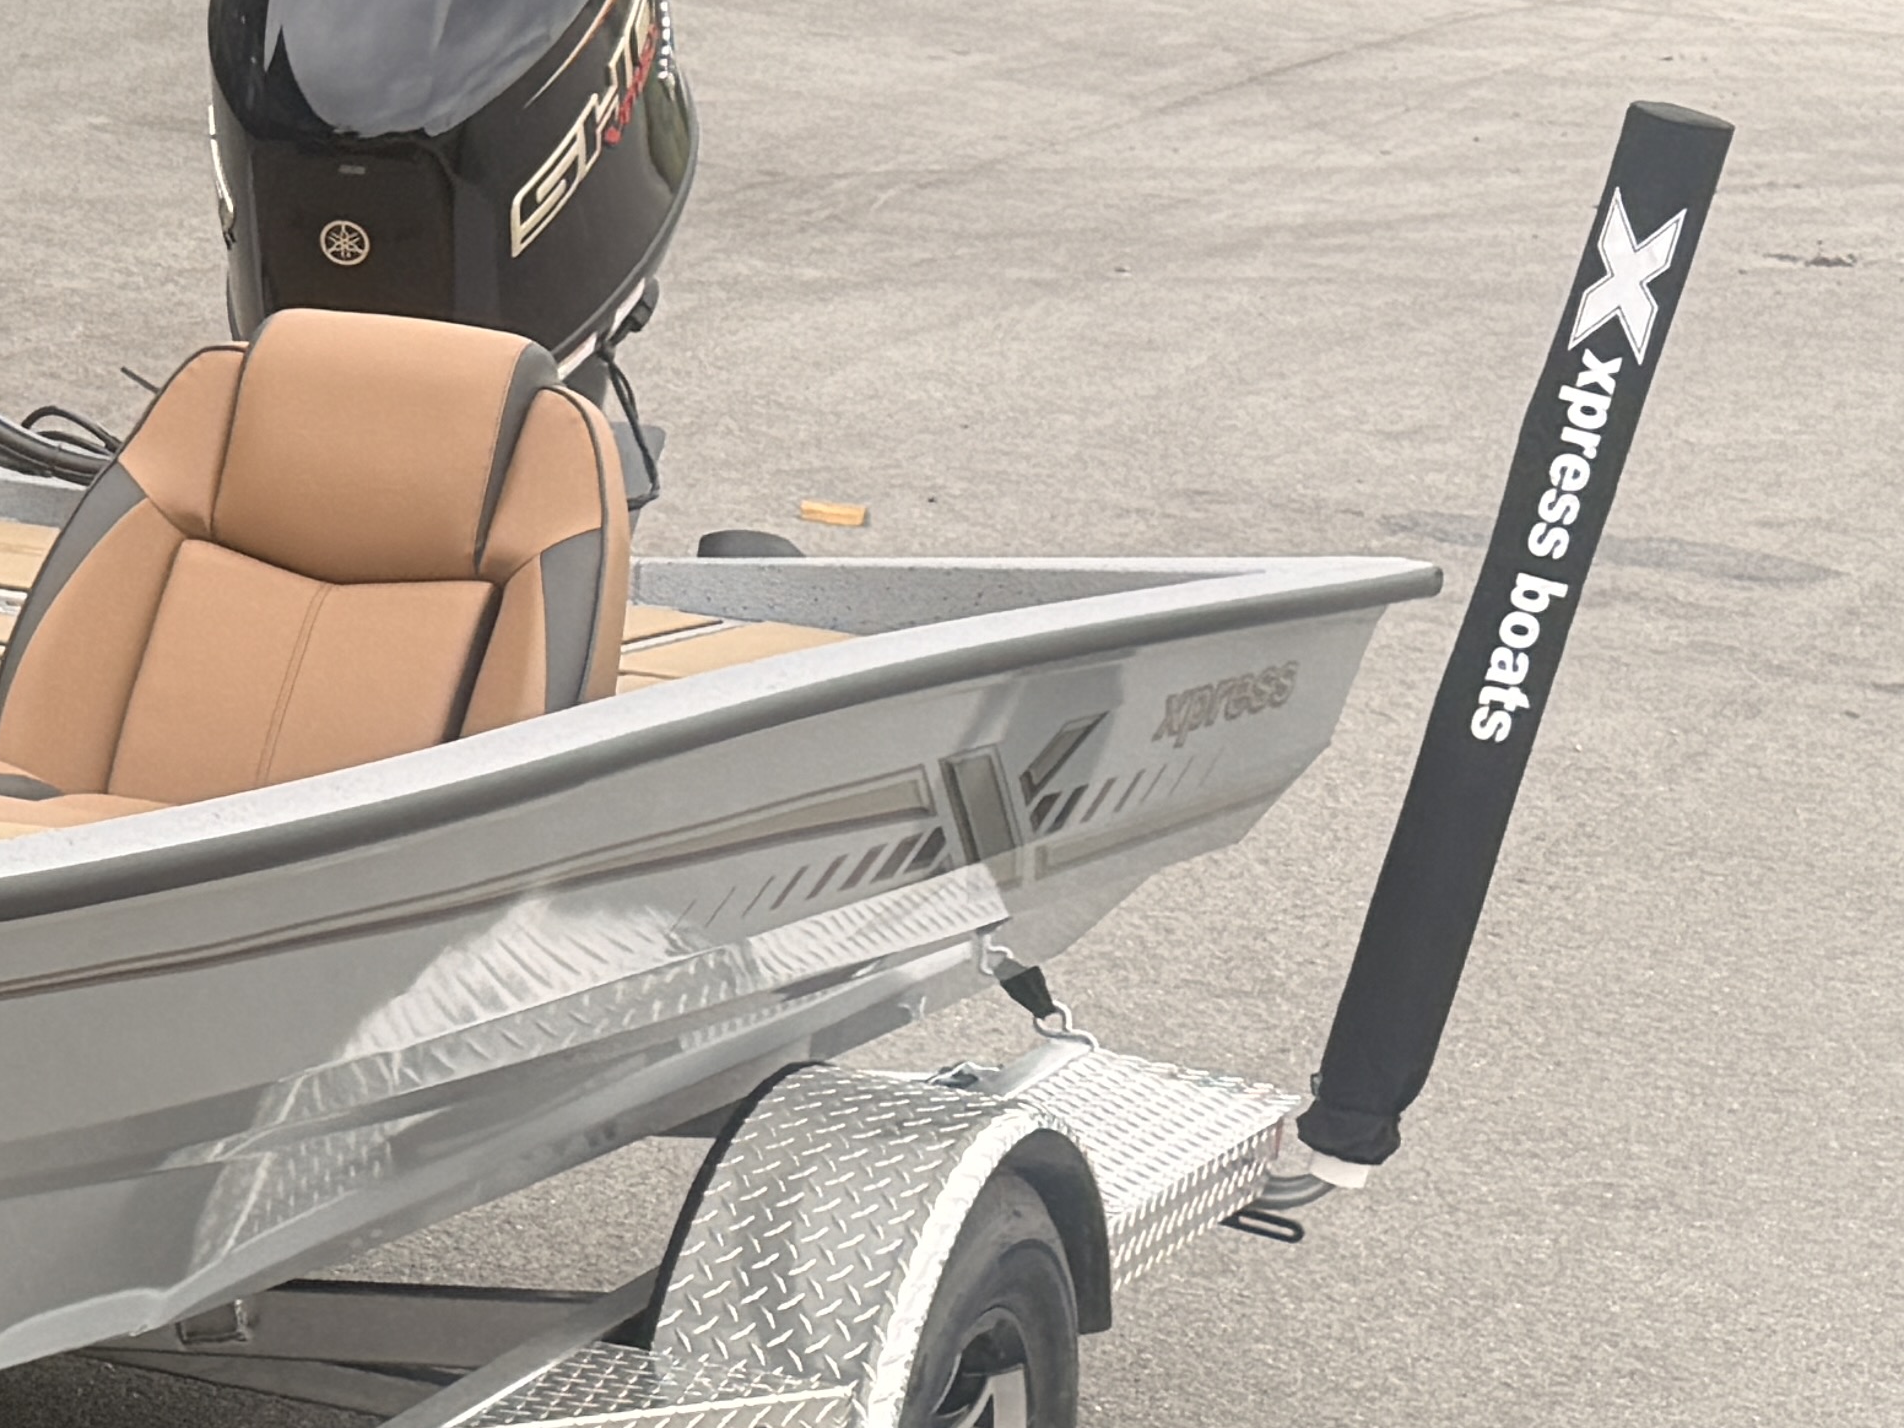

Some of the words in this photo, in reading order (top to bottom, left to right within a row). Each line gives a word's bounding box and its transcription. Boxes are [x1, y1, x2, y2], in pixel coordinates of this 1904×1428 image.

[1528, 347, 1623, 561] xpress
[1150, 659, 1300, 750] xpress
[1470, 571, 1569, 743] boats
